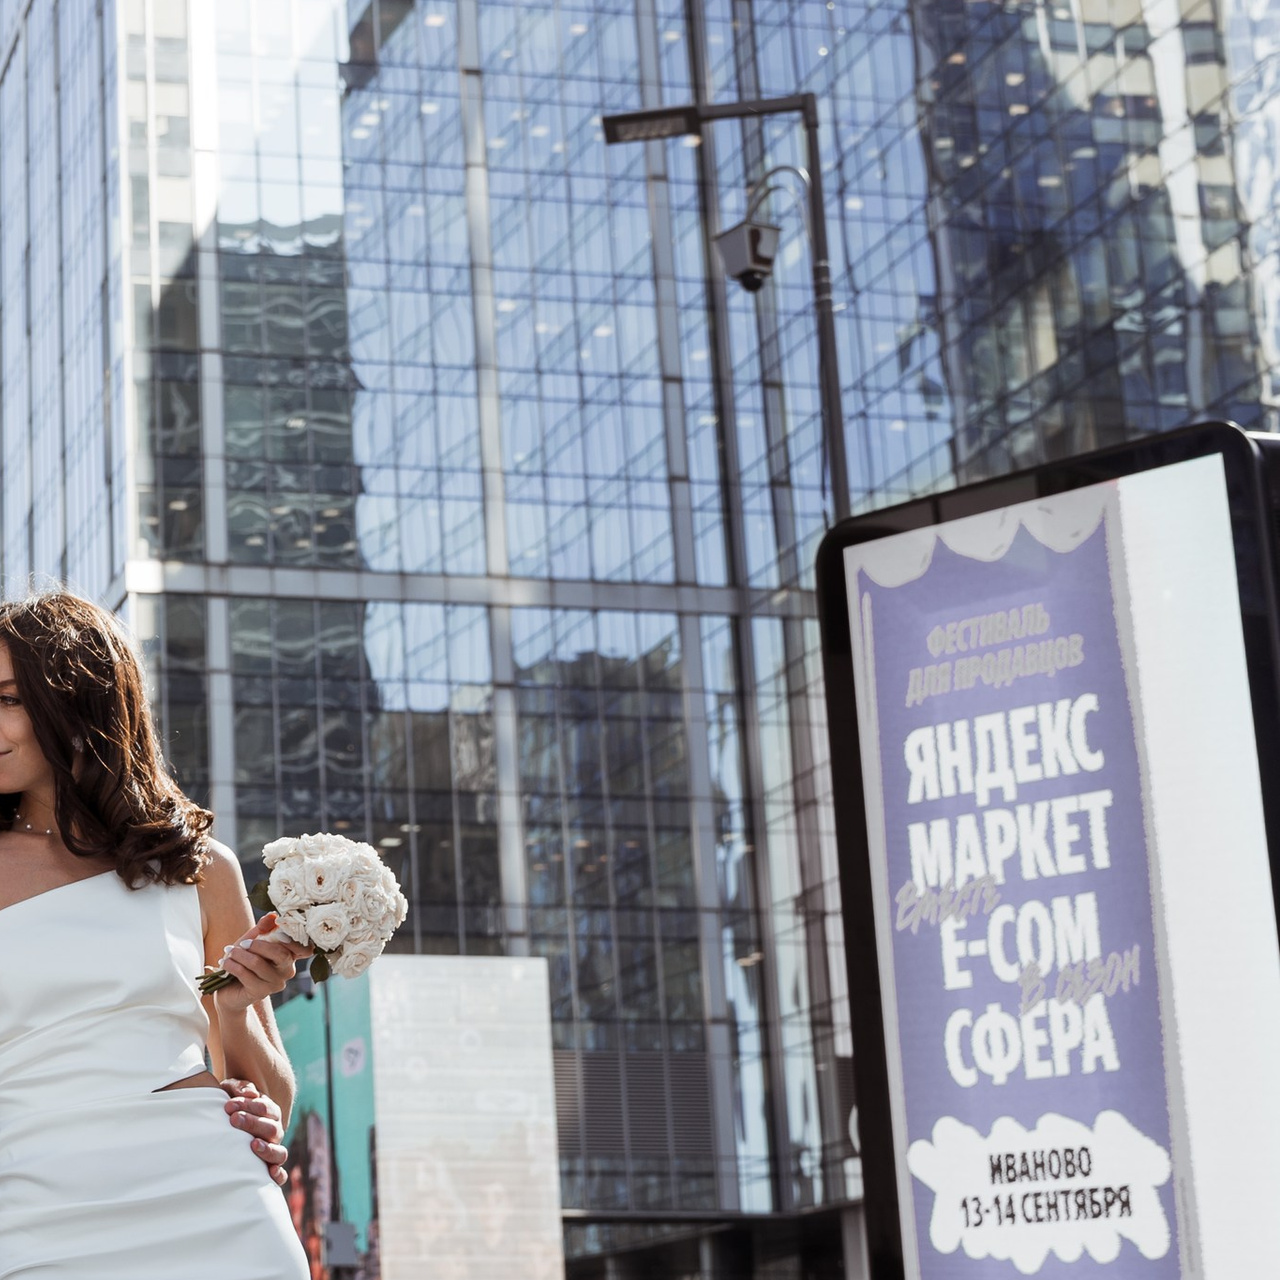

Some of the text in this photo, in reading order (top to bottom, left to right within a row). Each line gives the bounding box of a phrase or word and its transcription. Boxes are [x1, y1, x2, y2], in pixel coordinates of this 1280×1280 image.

[926, 603, 1050, 658] ФЕСТИВАЛЬ
[905, 633, 1085, 708] ДЛЯ ПРОДАВЦОВ
[904, 693, 1105, 807] ЯНДЕКС
[907, 789, 1113, 897] МАРКЕТ
[944, 992, 1121, 1088] СФЕРА
[989, 1146, 1093, 1185] ИВАНОВО
[961, 1185, 1132, 1228] 13-14 СЕНТЯБРЯ
